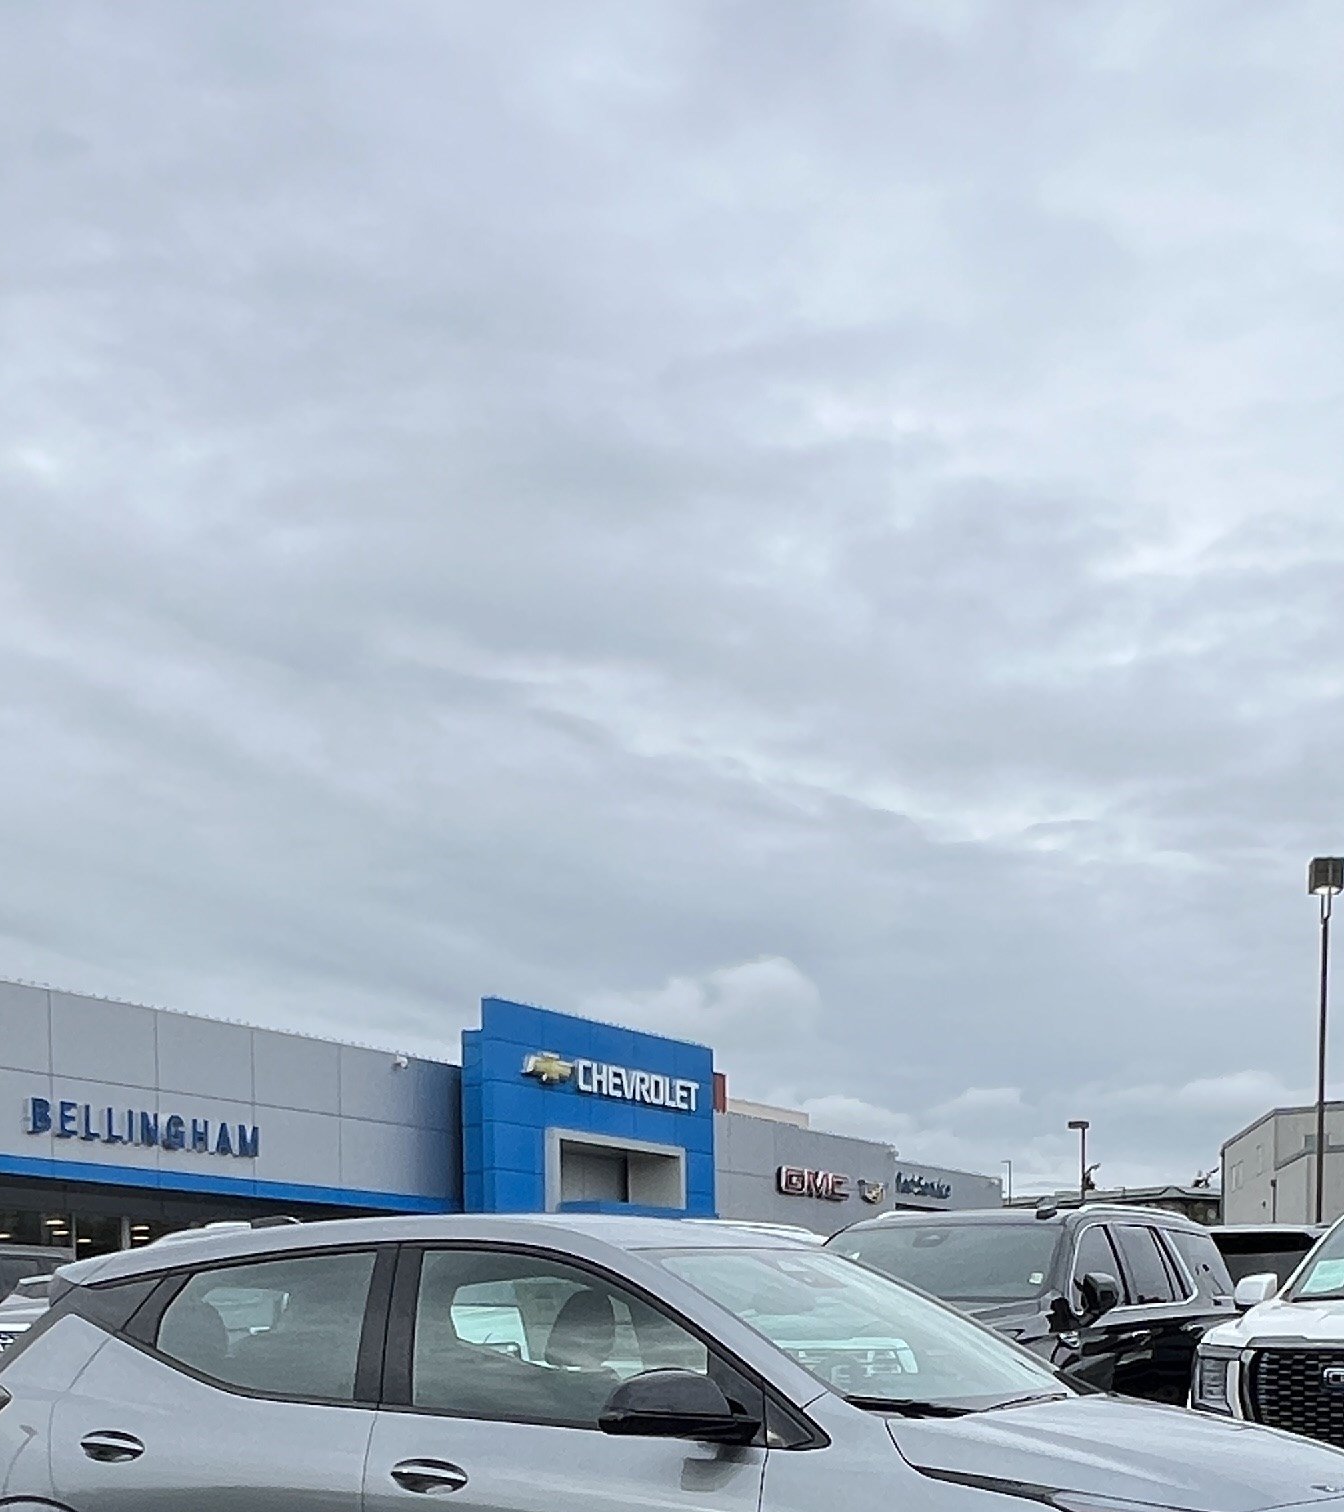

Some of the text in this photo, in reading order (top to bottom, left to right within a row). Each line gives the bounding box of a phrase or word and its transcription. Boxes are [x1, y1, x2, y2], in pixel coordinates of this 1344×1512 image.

[575, 1058, 700, 1112] CHEVROLET
[28, 1096, 260, 1158] BELLINGHAM
[777, 1165, 850, 1202] GMC
